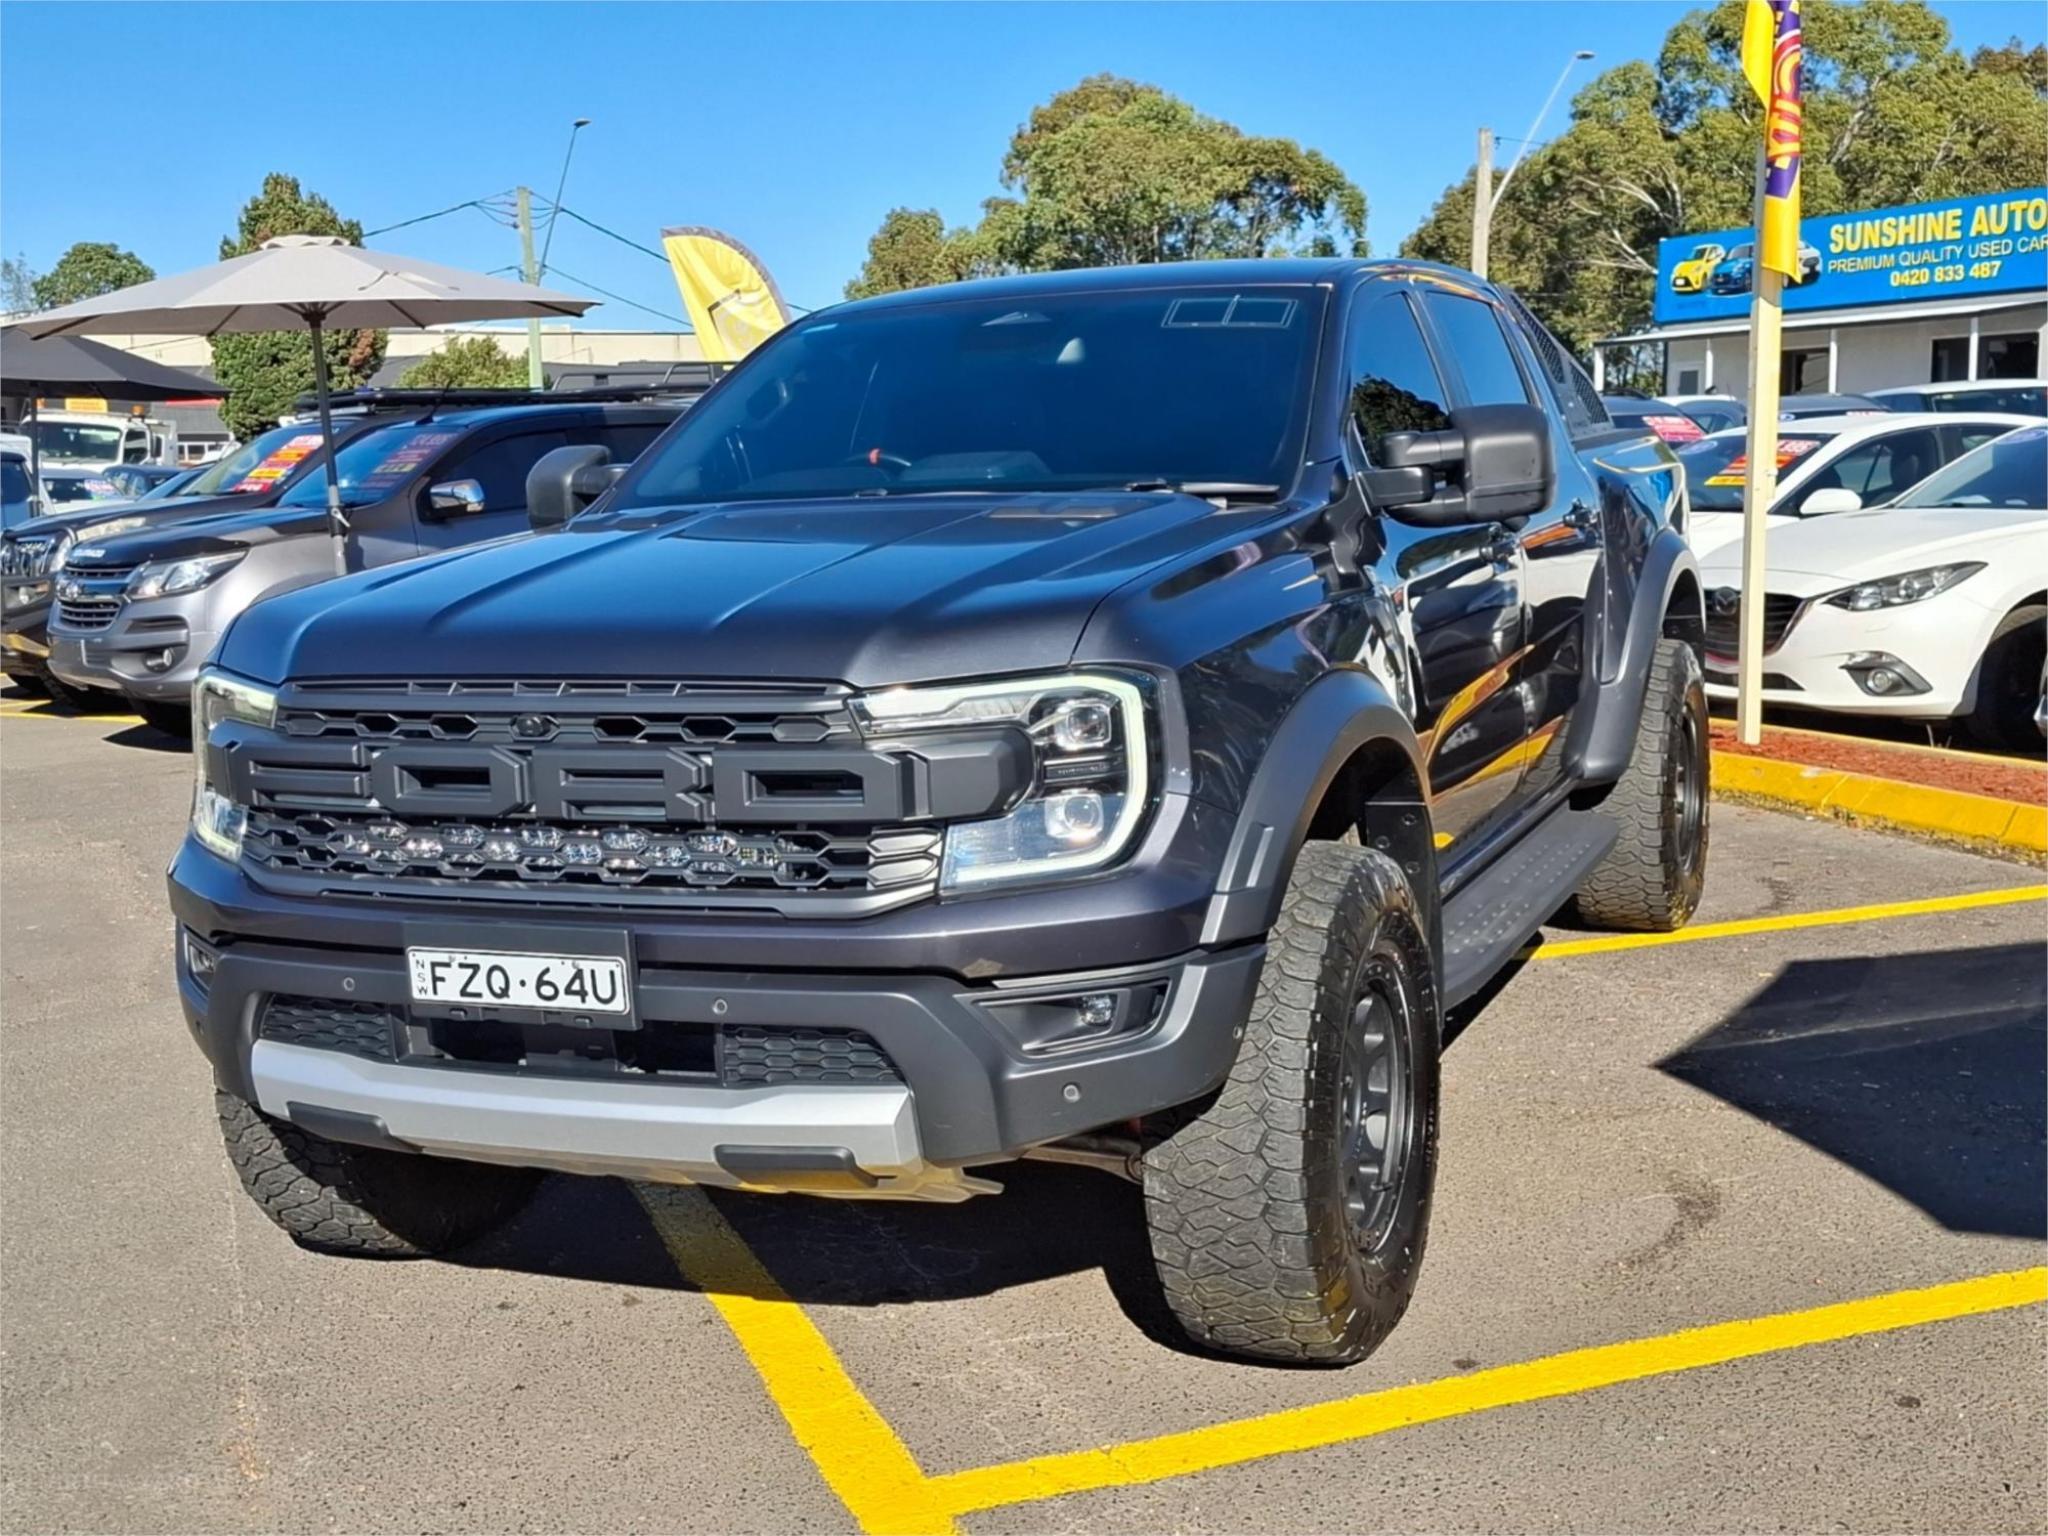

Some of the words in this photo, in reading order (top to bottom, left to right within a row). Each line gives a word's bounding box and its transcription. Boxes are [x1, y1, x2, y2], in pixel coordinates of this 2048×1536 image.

[1829, 208, 1962, 254] SUNSHINE
[1970, 198, 2047, 237] AUTO
[1828, 254, 1895, 273] PREMIUM
[1899, 245, 1964, 267] QUALITY
[1968, 239, 2013, 258] USED
[1890, 268, 1929, 287] 0420
[1934, 265, 1964, 282] 833
[1969, 261, 2002, 278] 487
[230, 743, 902, 823] FORD
